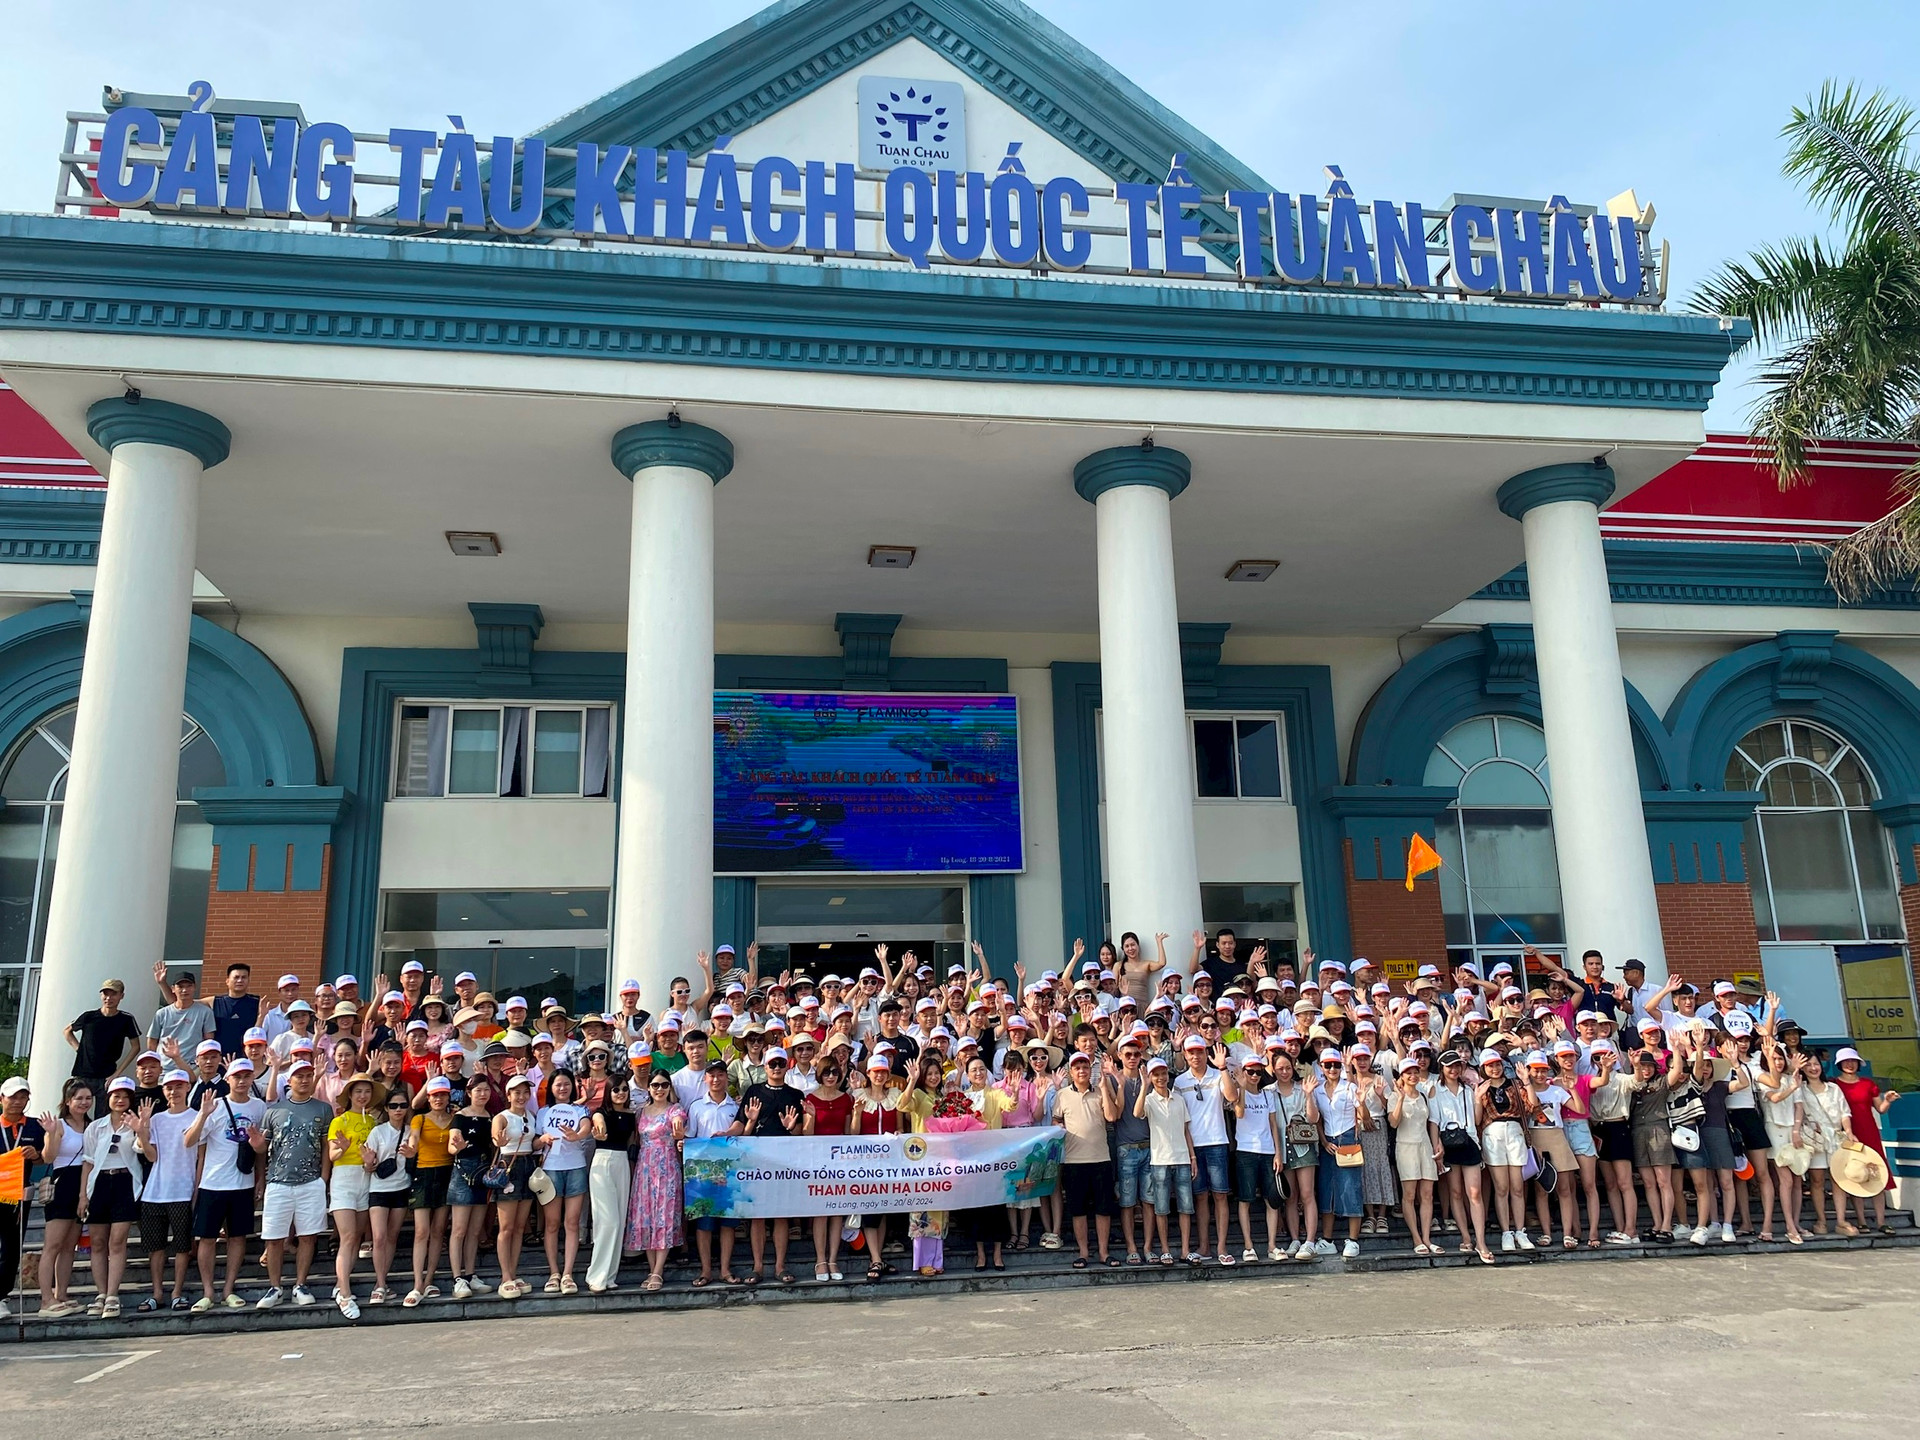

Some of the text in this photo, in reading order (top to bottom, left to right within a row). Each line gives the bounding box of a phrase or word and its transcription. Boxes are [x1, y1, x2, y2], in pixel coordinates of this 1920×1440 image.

[97, 80, 1643, 302] CẢNG TÀU KHÁCH QUỐC TẾ TUẦN CHÂU
[857, 706, 929, 723] FLAMINGO
[1386, 964, 1405, 974] TOILET
[1866, 1005, 1904, 1018] close
[1740, 1021, 1750, 1029] 15
[1872, 1024, 1903, 1035] 22 pm
[547, 1117, 561, 1128] XE
[831, 1144, 890, 1159] FLAMINGO
[736, 1161, 1018, 1181] CHÀO MỪNG TỔNG CÔNG TY MAY BẮC GIANG BGG
[807, 1181, 953, 1196] THAM QUAN HẠ LONG
